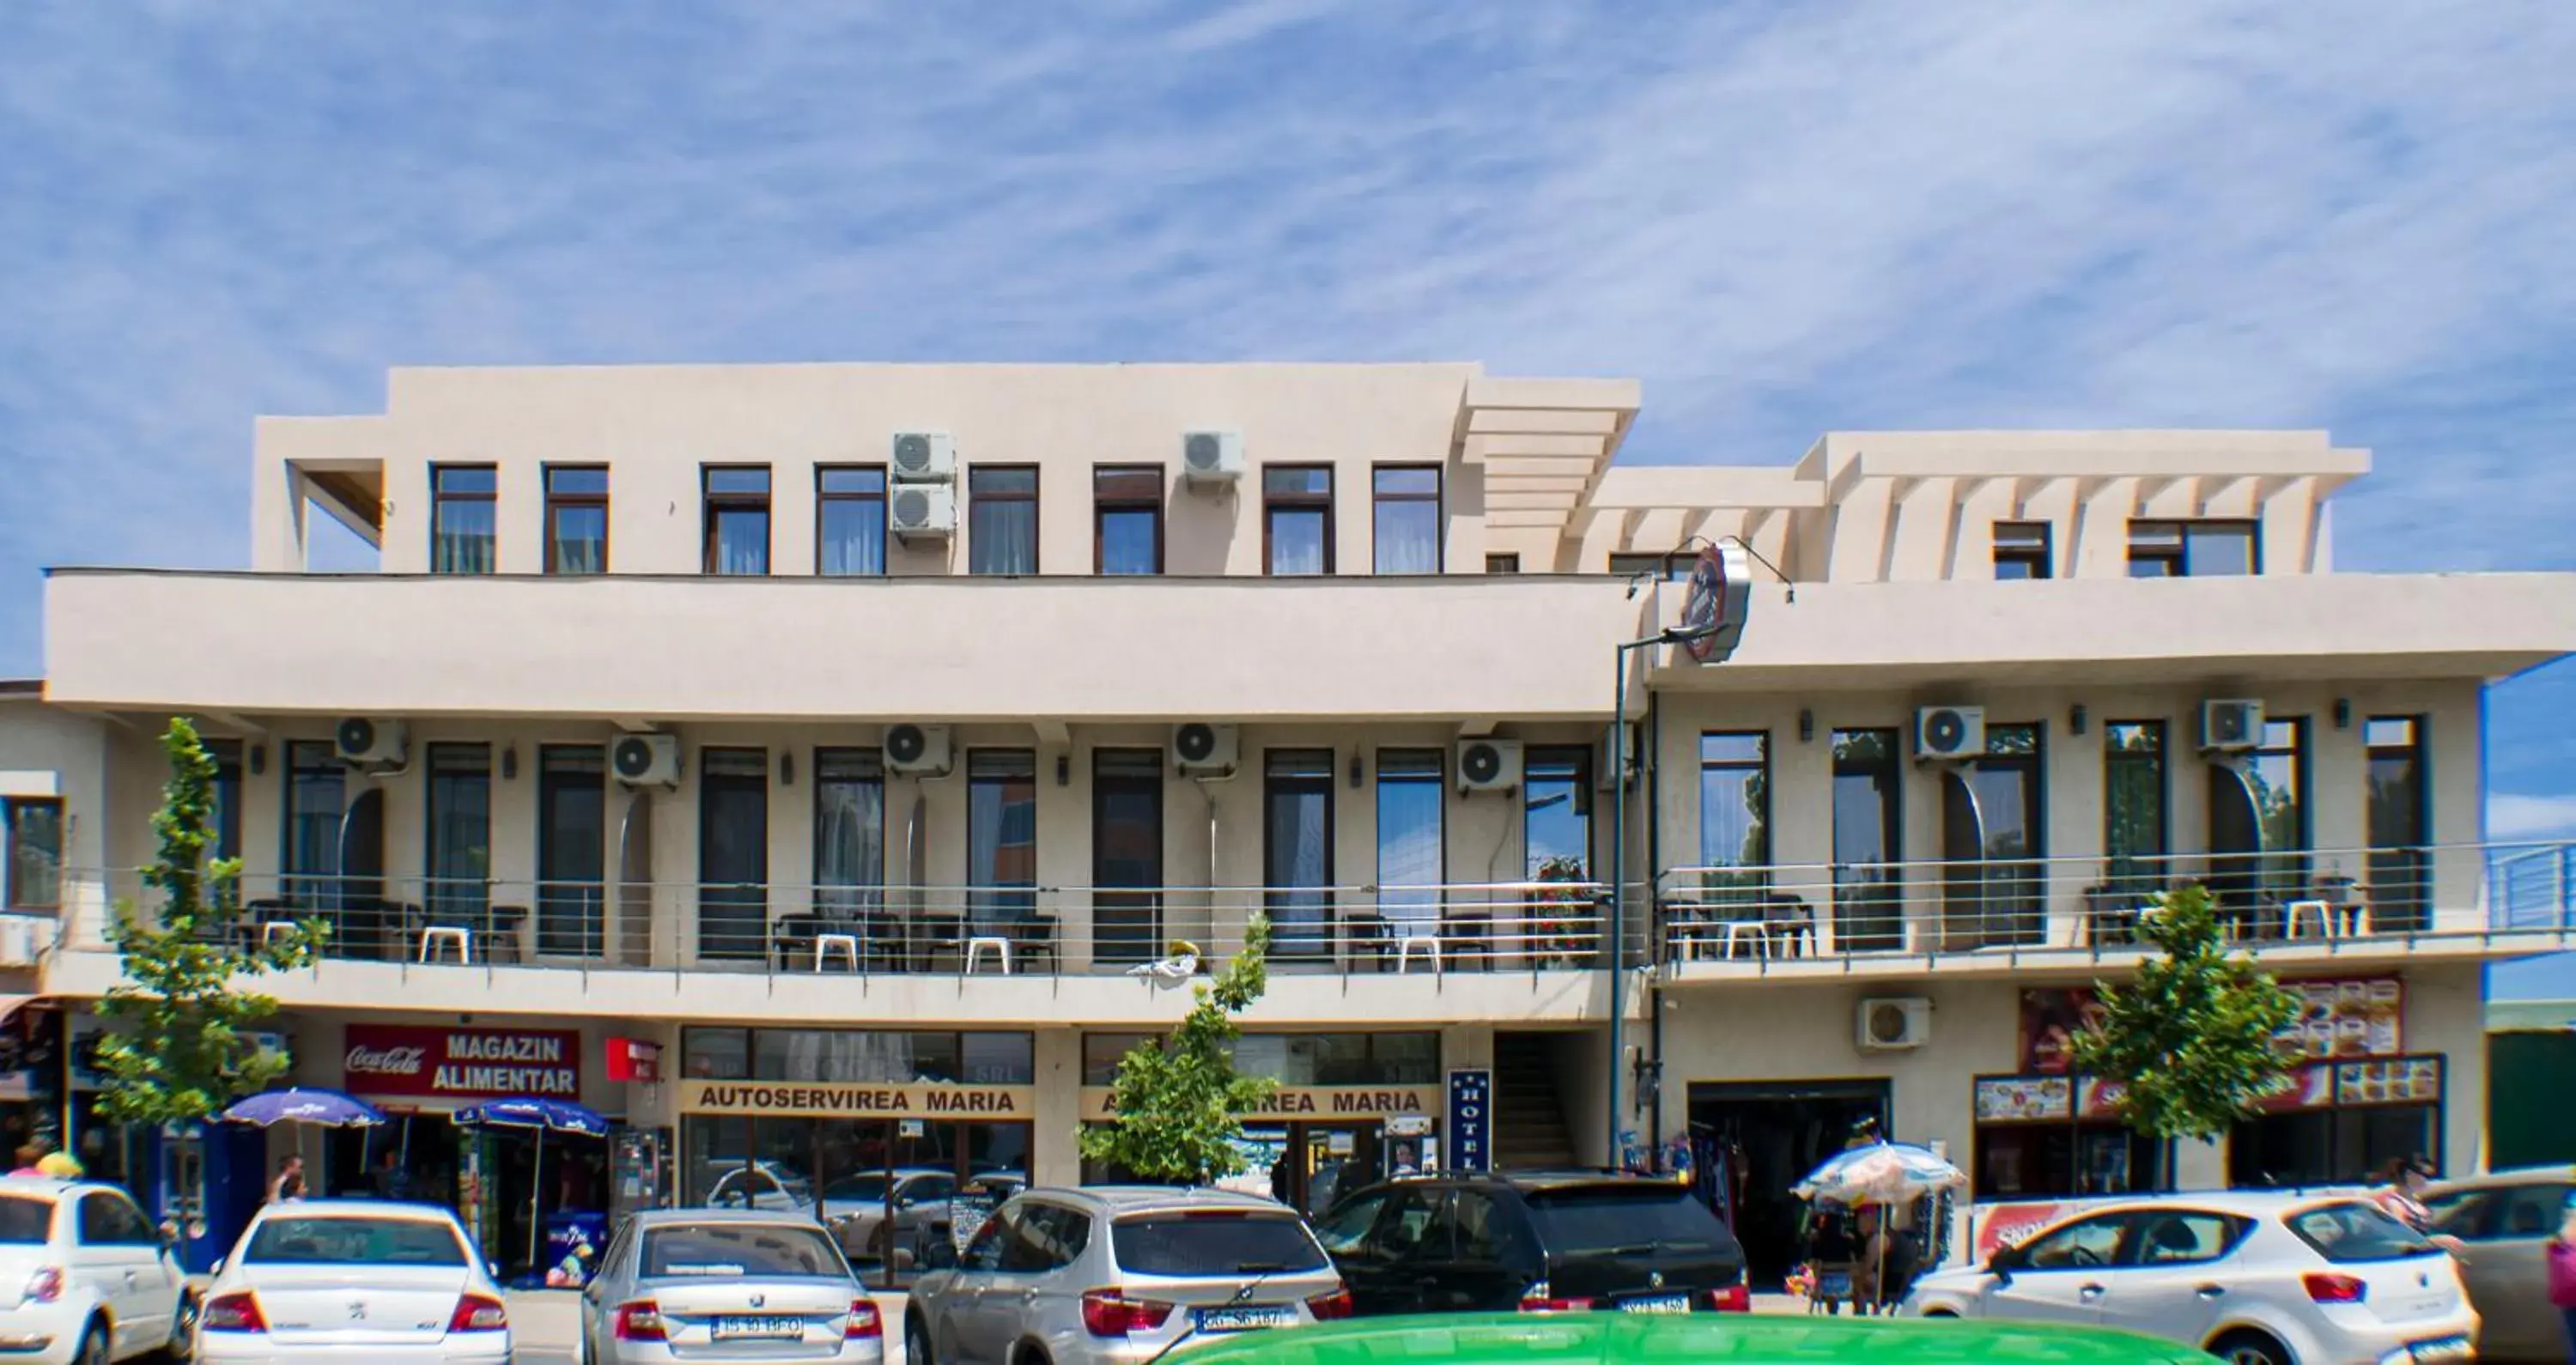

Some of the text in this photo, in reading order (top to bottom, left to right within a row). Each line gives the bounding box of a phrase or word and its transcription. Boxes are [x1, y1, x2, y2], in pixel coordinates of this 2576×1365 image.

[447, 1034, 560, 1061] MAGAZIN
[433, 1065, 575, 1093] ALIMENTAR
[700, 1086, 1015, 1112] AUTOSERVIREA MARIA
[1333, 1090, 1421, 1113] MARIA
[1461, 1088, 1479, 1169] HOTEL
